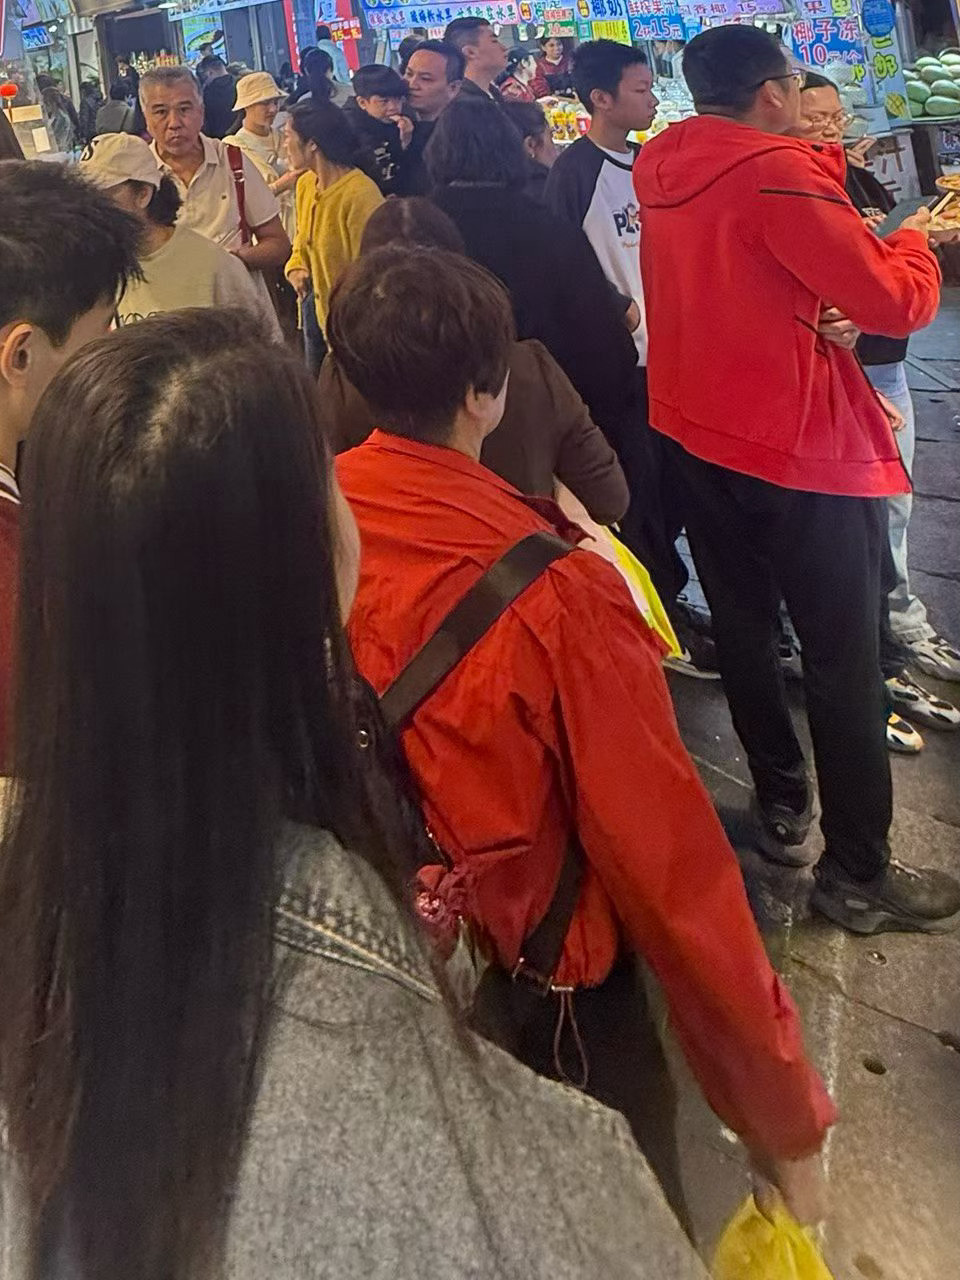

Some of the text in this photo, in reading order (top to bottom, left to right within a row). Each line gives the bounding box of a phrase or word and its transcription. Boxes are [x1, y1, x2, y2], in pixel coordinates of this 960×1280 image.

[634, 19, 682, 38] 2杯15元
[794, 20, 858, 43] 椰子冻
